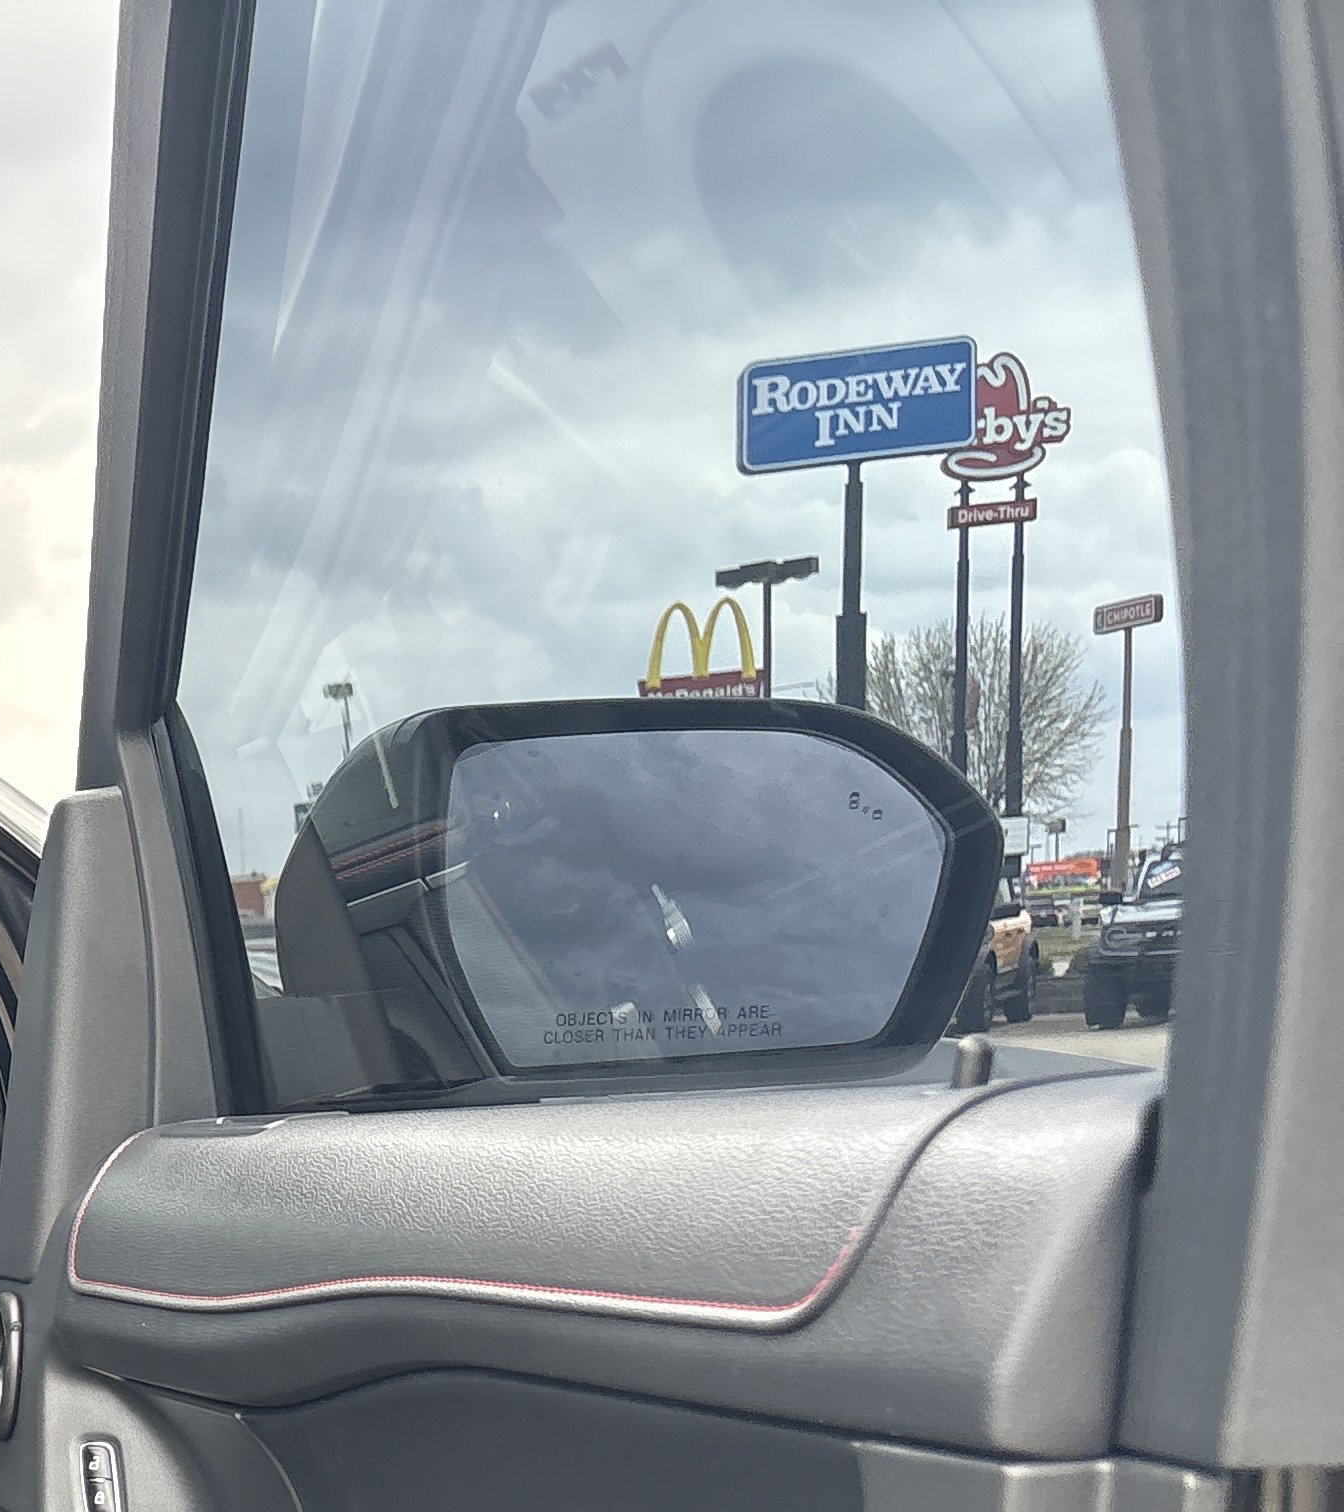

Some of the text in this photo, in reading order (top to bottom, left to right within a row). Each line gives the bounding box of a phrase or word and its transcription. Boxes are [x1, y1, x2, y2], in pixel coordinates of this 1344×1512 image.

[752, 363, 967, 416] RODEWAY
[814, 401, 901, 448] INN
[958, 506, 1029, 523] Drive-Thru
[1106, 602, 1152, 625] CHIPOTLE
[556, 1005, 770, 1027] OBJECTS IN MIRROR ARE
[544, 1022, 782, 1044] CLOSER THAN THEY APPEAR
